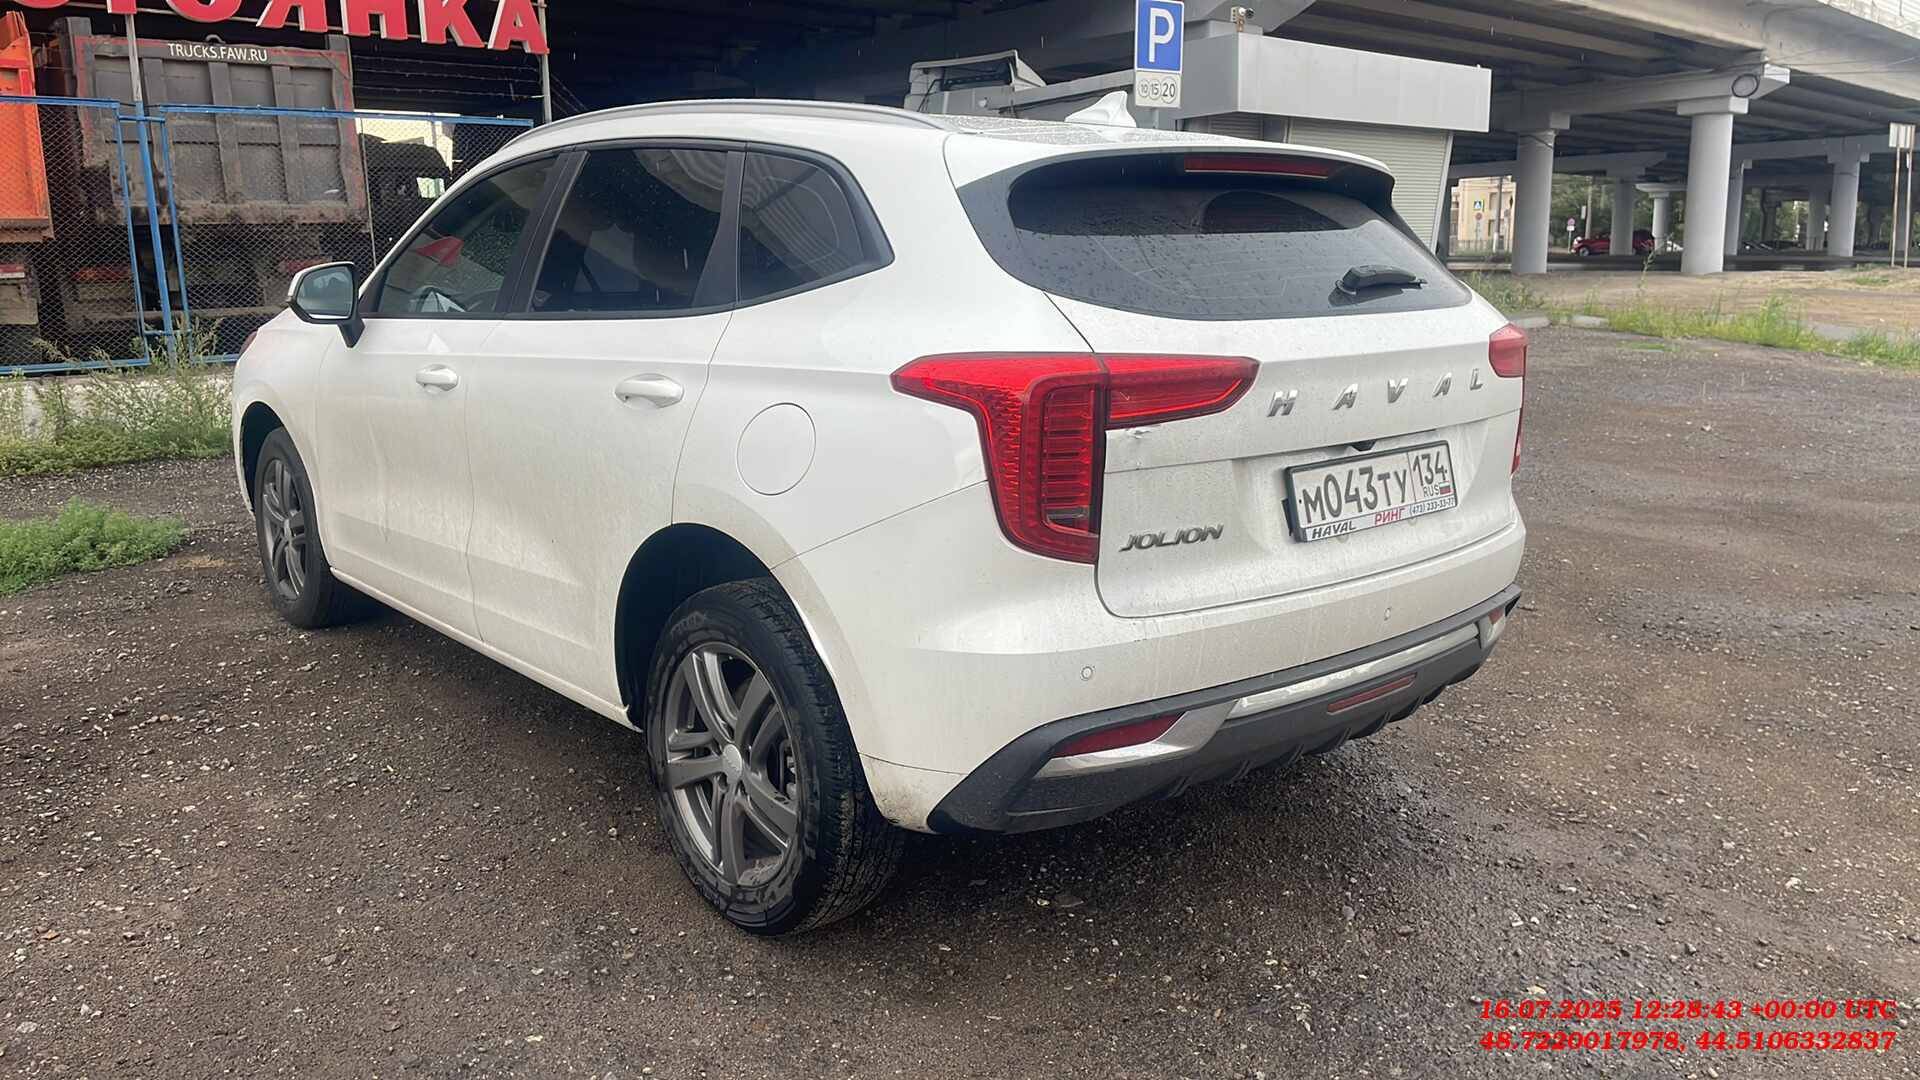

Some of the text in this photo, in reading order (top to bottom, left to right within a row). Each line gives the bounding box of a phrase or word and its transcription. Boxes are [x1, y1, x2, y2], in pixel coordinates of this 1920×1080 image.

[167, 43, 268, 62] TRUCKS.FAW.RU
[1162, 82, 1176, 98] 20
[1267, 368, 1484, 418] HAVAL
[1413, 451, 1447, 487] 134
[1423, 484, 1440, 498] RUS
[1118, 523, 1224, 552] JOLION
[1312, 520, 1357, 539] HAVAL
[1374, 507, 1406, 526] РИНГ
